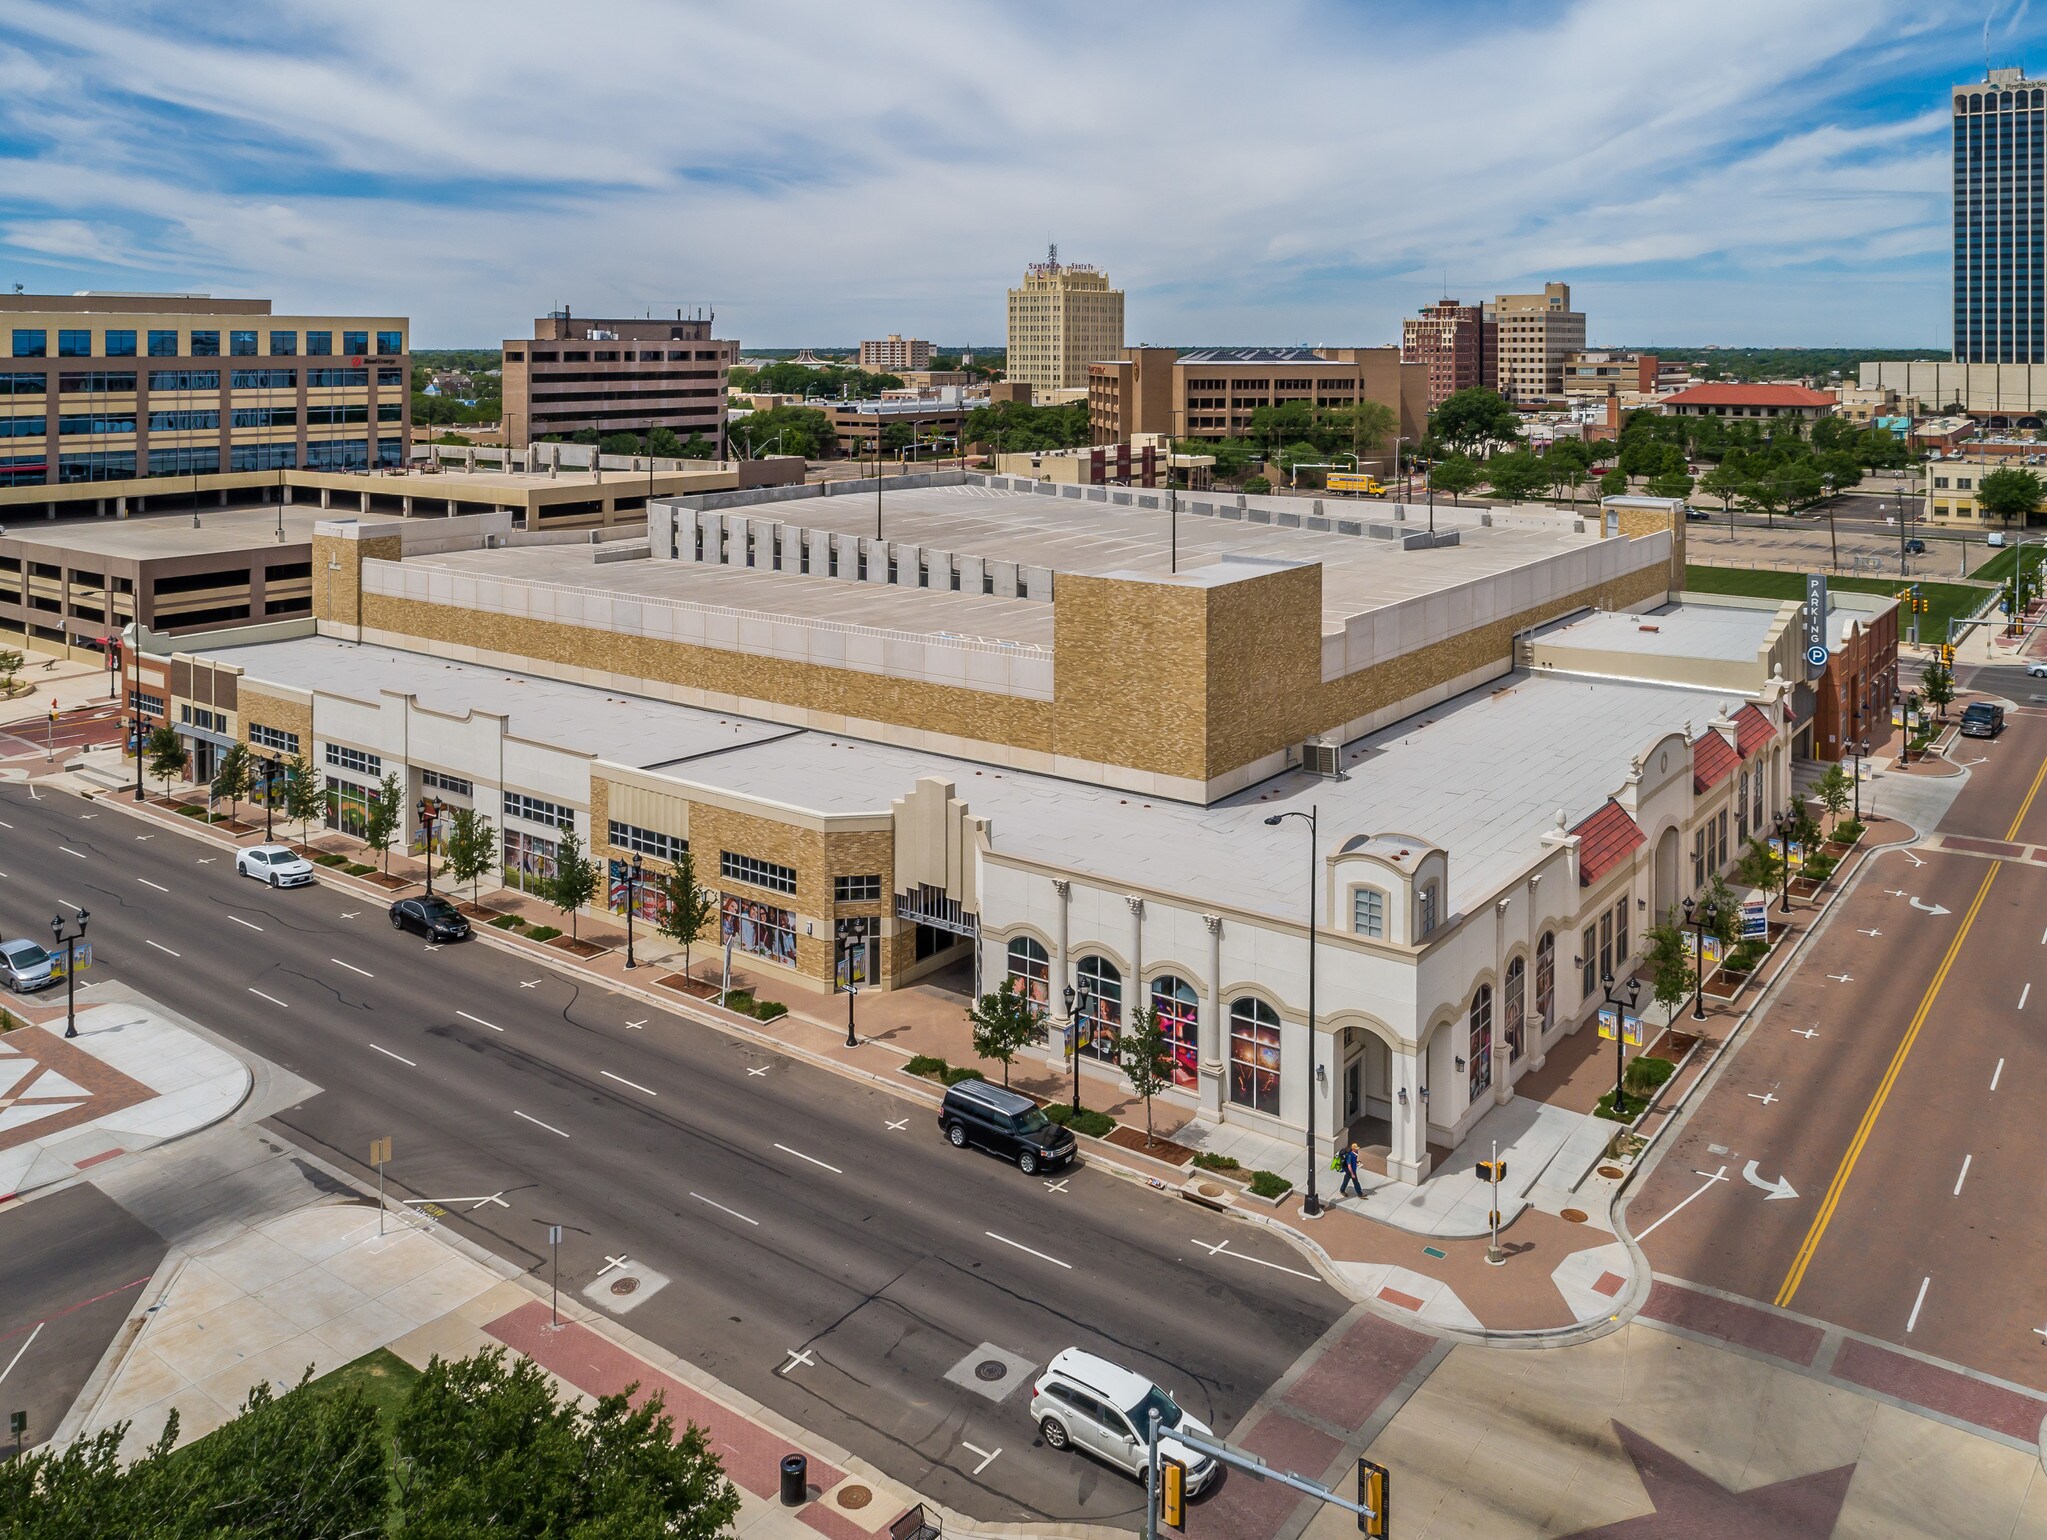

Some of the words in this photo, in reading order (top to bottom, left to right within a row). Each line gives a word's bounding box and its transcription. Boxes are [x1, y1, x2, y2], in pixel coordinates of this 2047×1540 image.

[1028, 262, 1050, 270] Santa
[1071, 262, 1087, 270] Santa
[1810, 580, 1820, 643] PARKING
[1812, 650, 1823, 661] P
